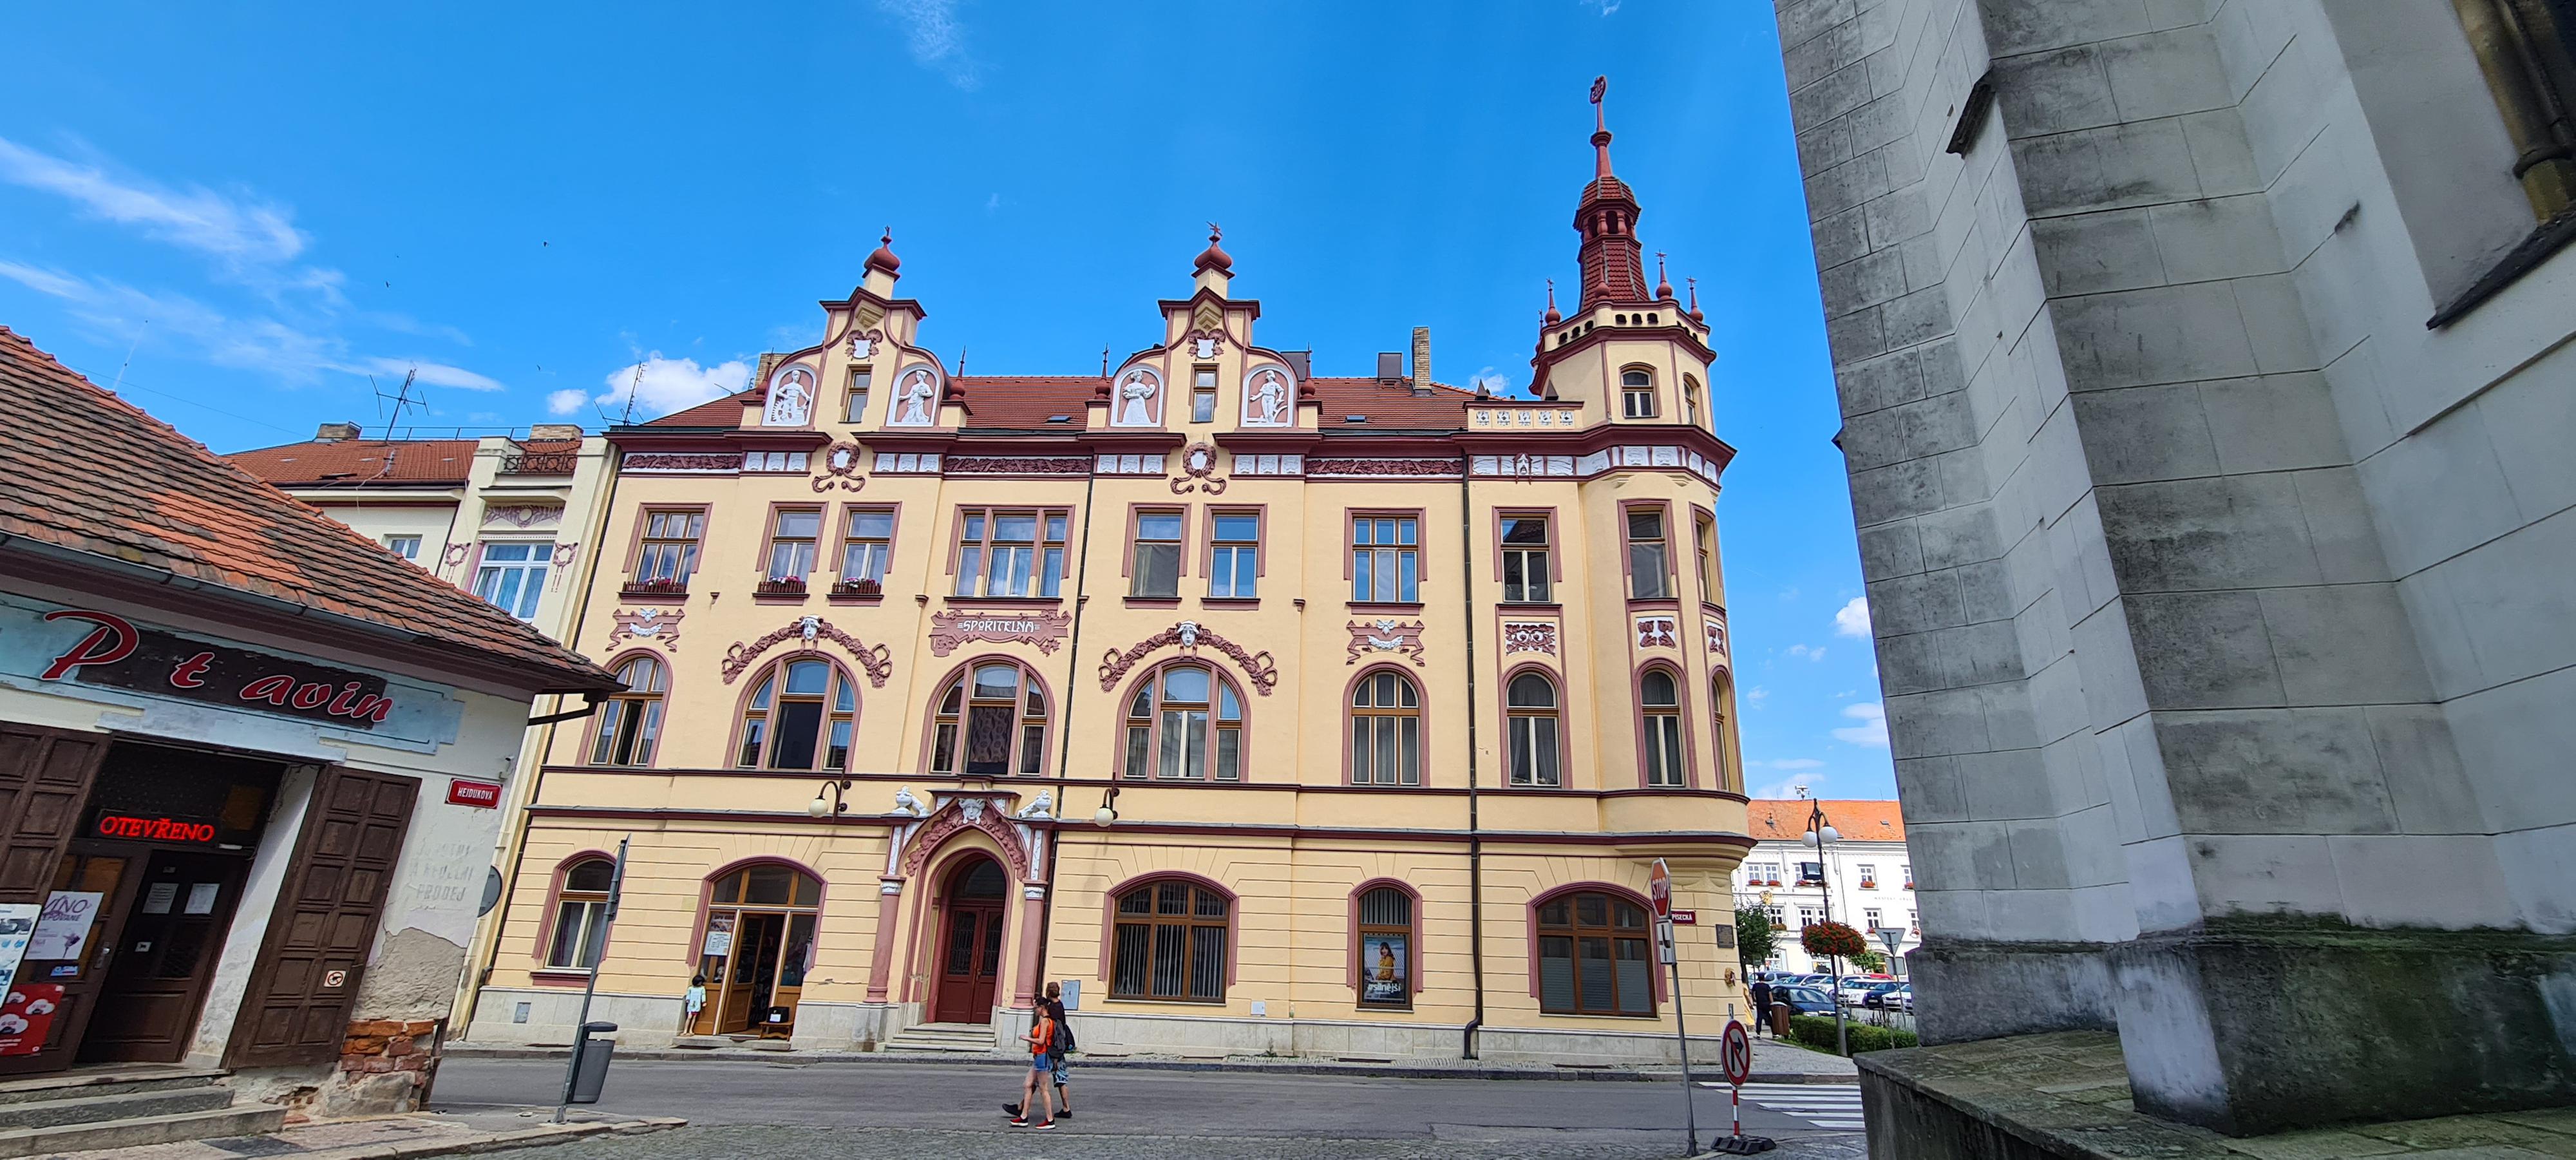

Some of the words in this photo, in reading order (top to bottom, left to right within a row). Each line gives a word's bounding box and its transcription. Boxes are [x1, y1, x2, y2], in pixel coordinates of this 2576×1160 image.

[963, 619, 1034, 632] SPOŘITELNA
[457, 787, 493, 800] HEJDUKOVA
[100, 816, 215, 841] OTEVŘENO
[1652, 877, 1667, 900] STOP
